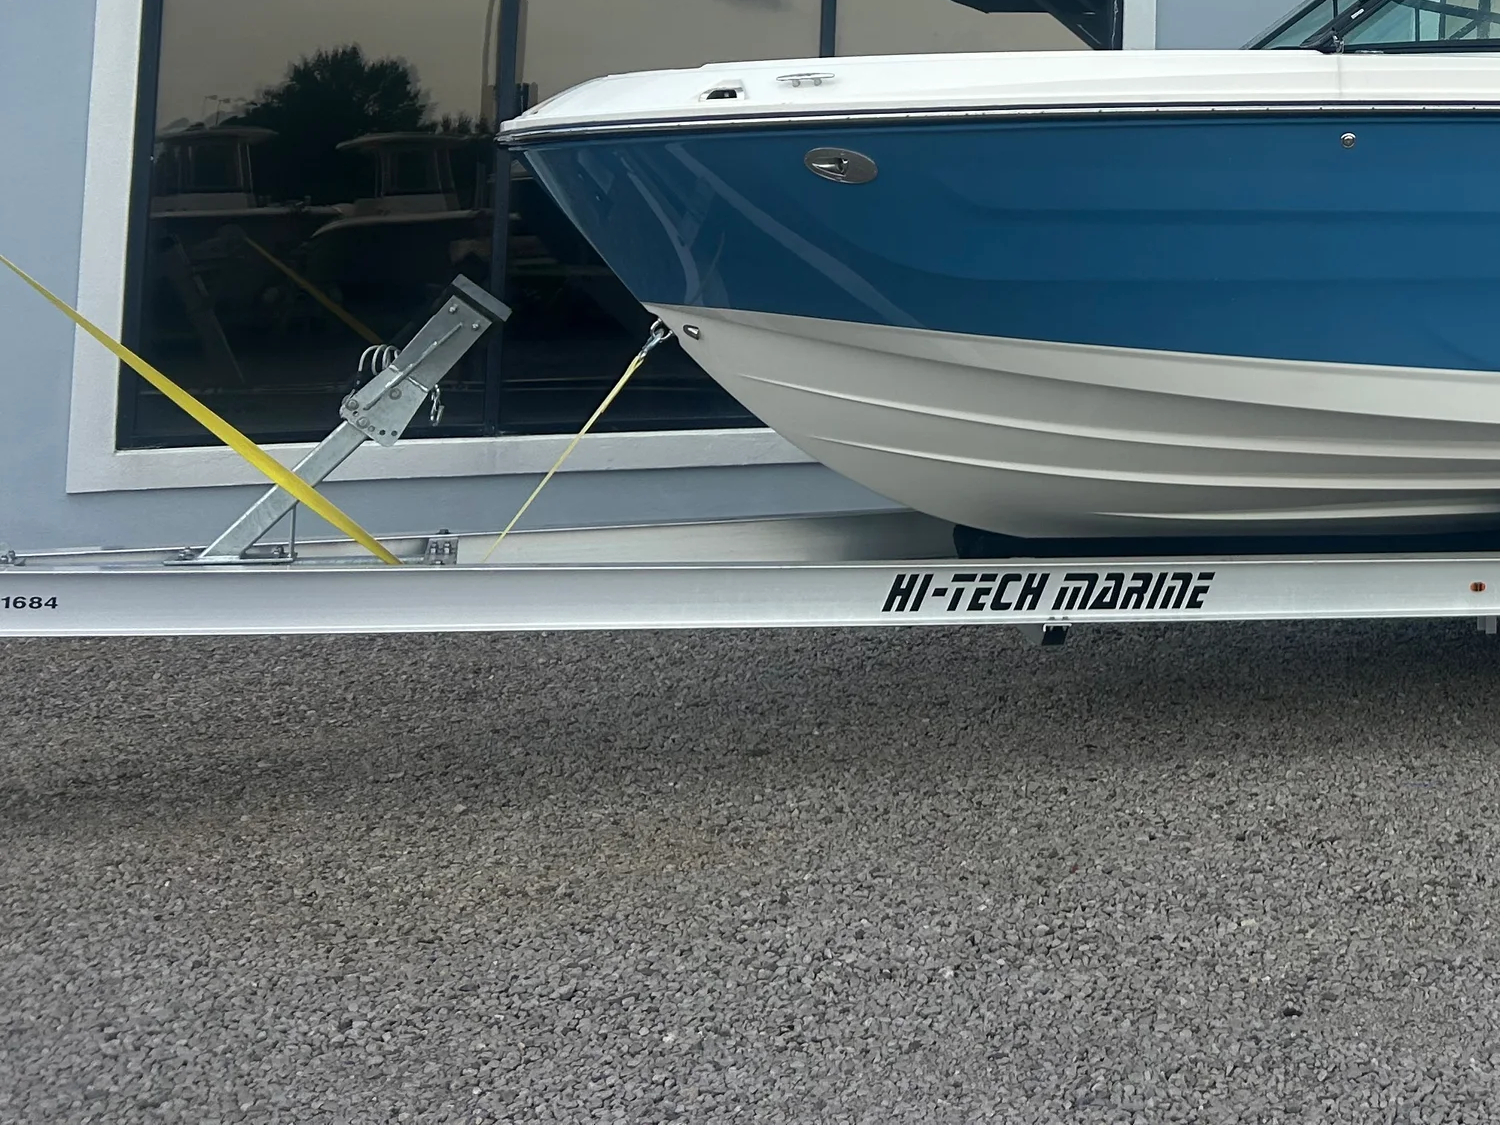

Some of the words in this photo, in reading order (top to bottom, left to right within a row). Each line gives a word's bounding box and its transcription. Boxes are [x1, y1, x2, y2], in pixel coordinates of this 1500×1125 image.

[1, 596, 59, 609] 1684
[882, 573, 1050, 612] HI-TECH
[1051, 572, 1216, 611] MARINE
